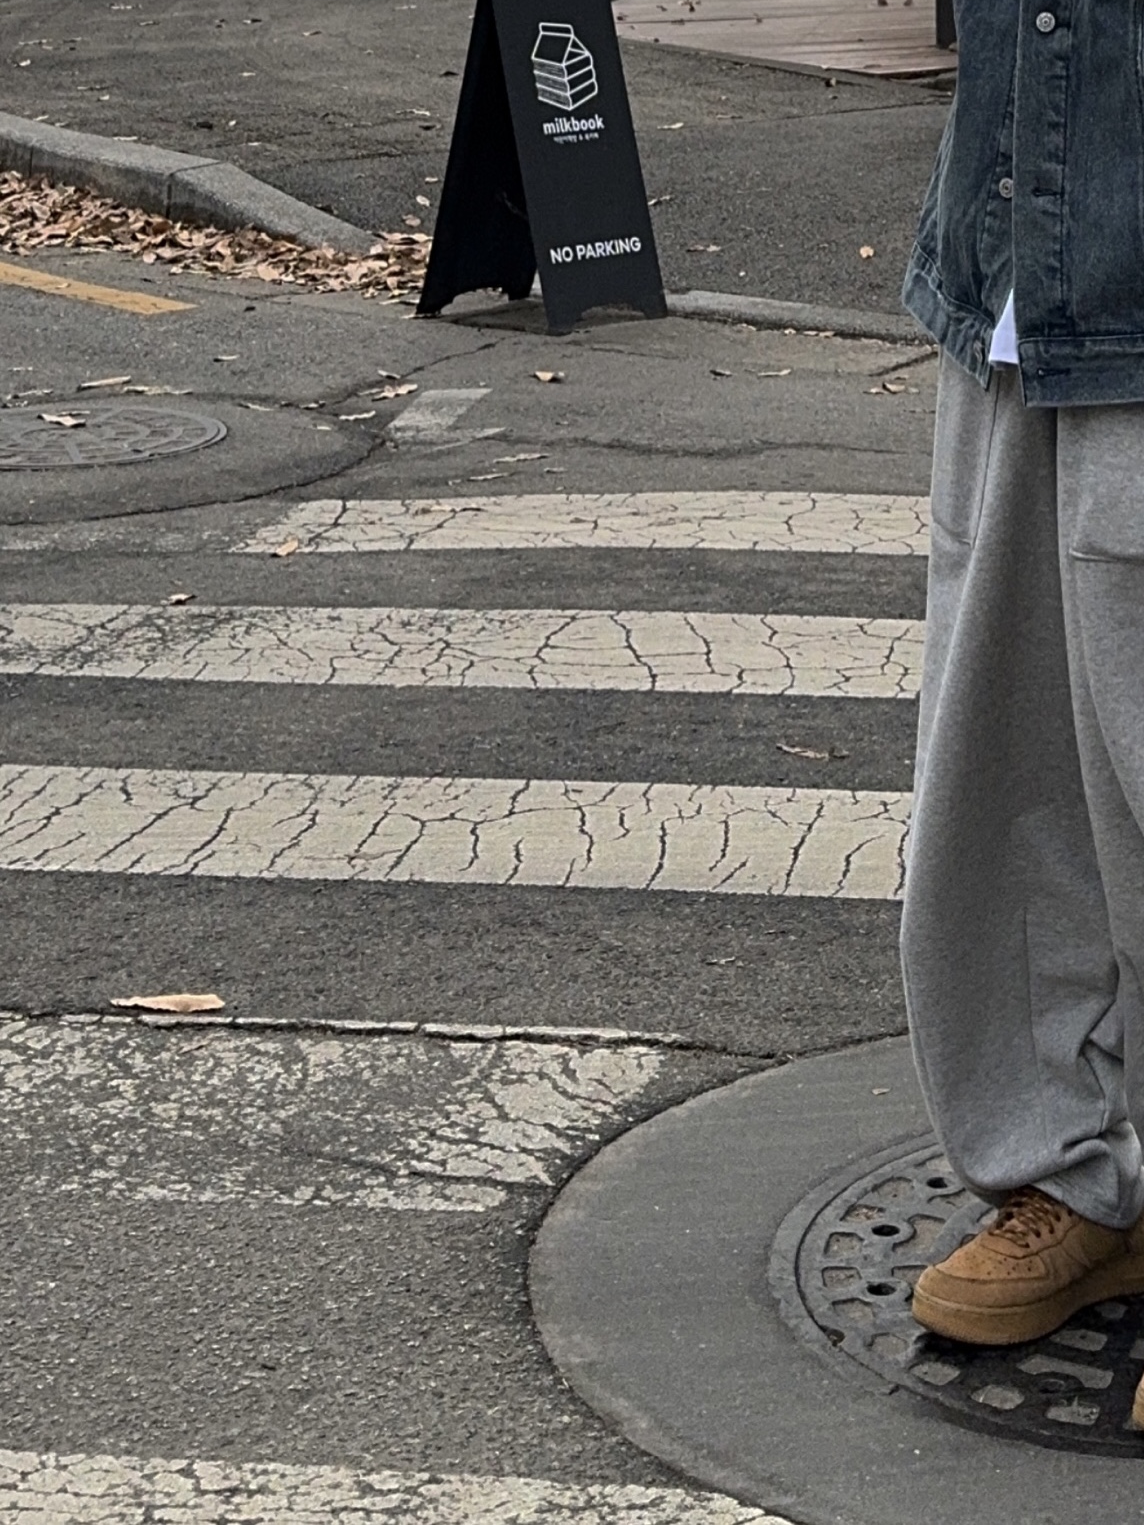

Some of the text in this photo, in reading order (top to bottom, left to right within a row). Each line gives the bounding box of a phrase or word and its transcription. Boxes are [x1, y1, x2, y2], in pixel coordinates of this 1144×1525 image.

[542, 113, 605, 136] milkbook
[549, 236, 642, 265] NO PARKING
